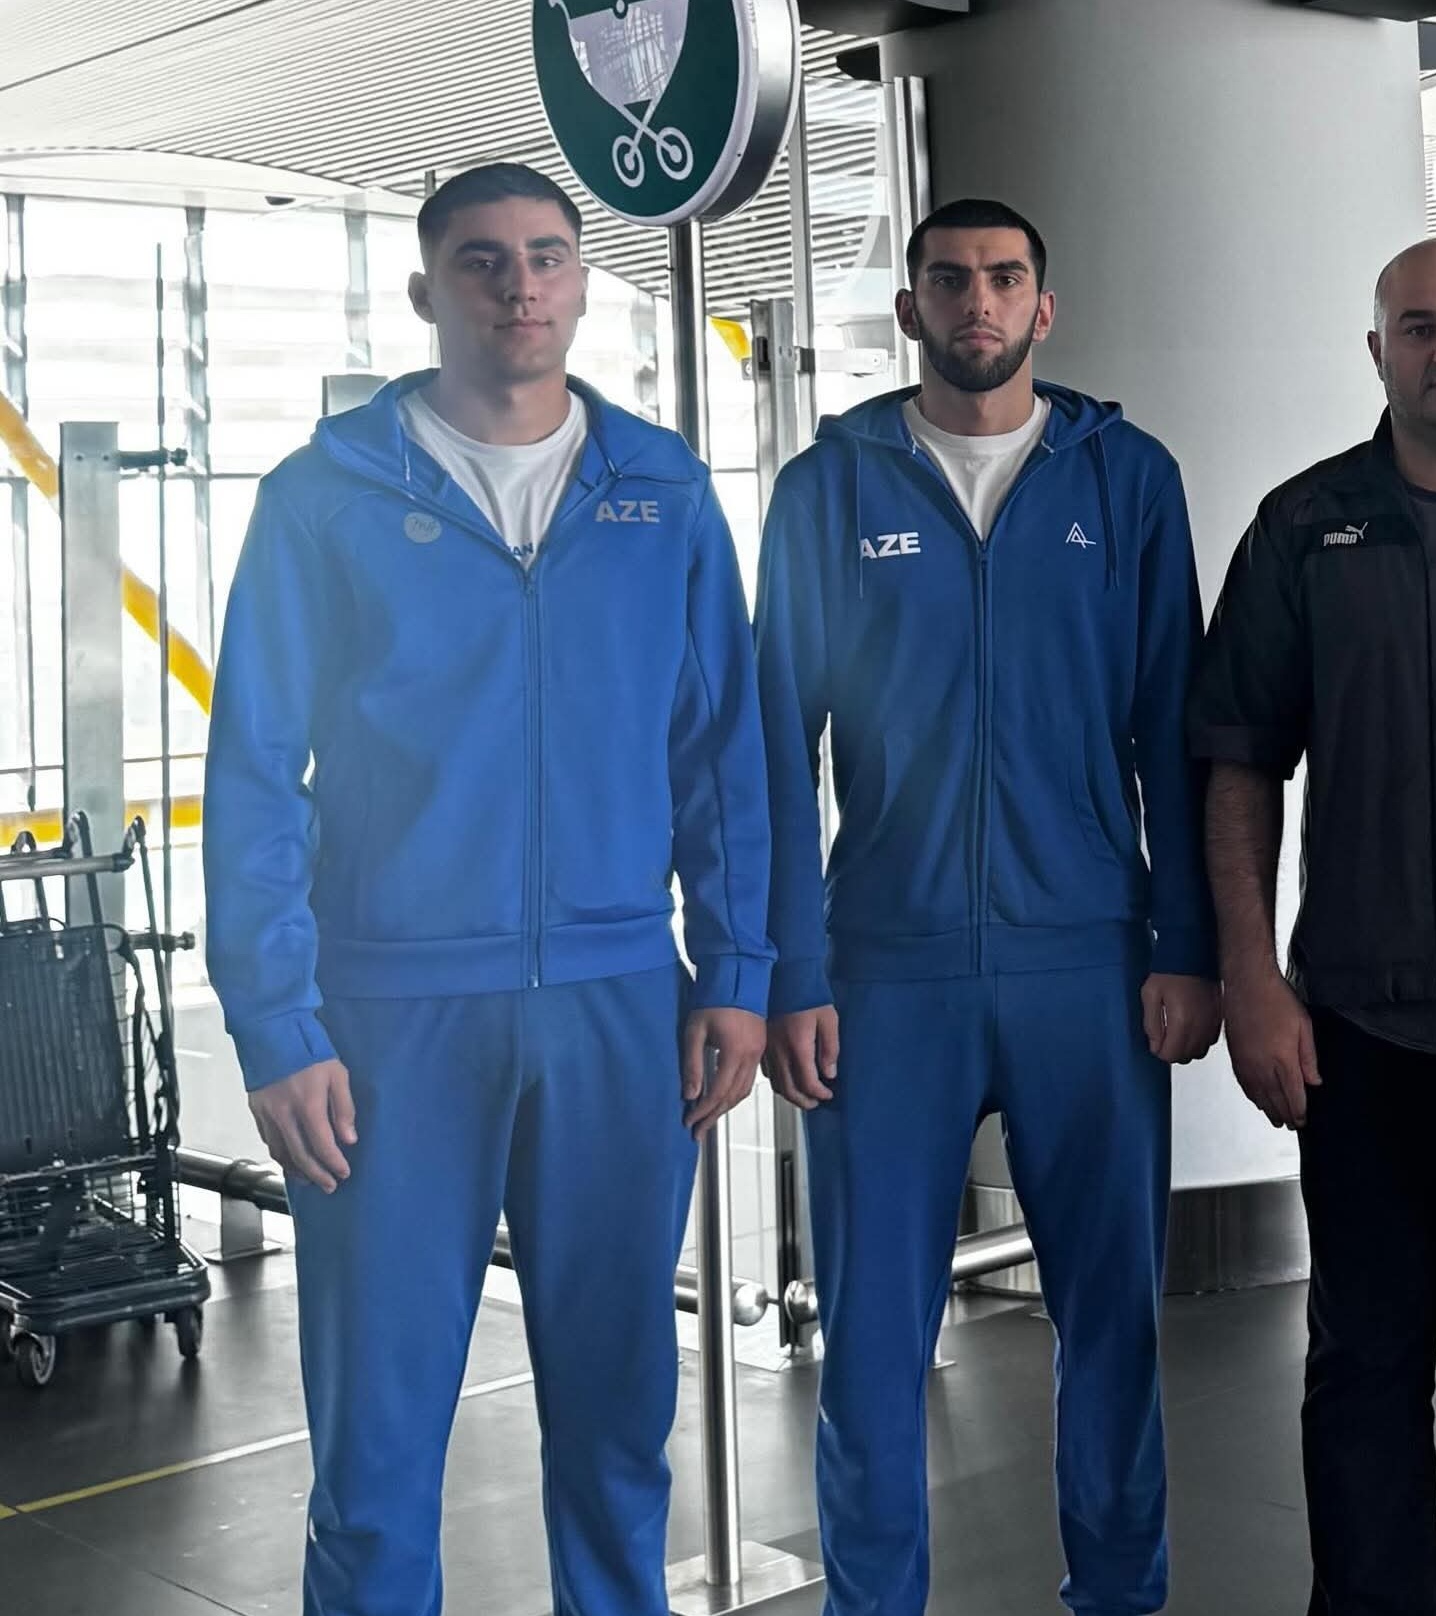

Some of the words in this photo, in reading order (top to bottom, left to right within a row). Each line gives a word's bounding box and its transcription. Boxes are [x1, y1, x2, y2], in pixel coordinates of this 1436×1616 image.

[594, 500, 660, 522] AZE
[860, 532, 921, 559] AZE
[1323, 532, 1358, 547] PUMA
